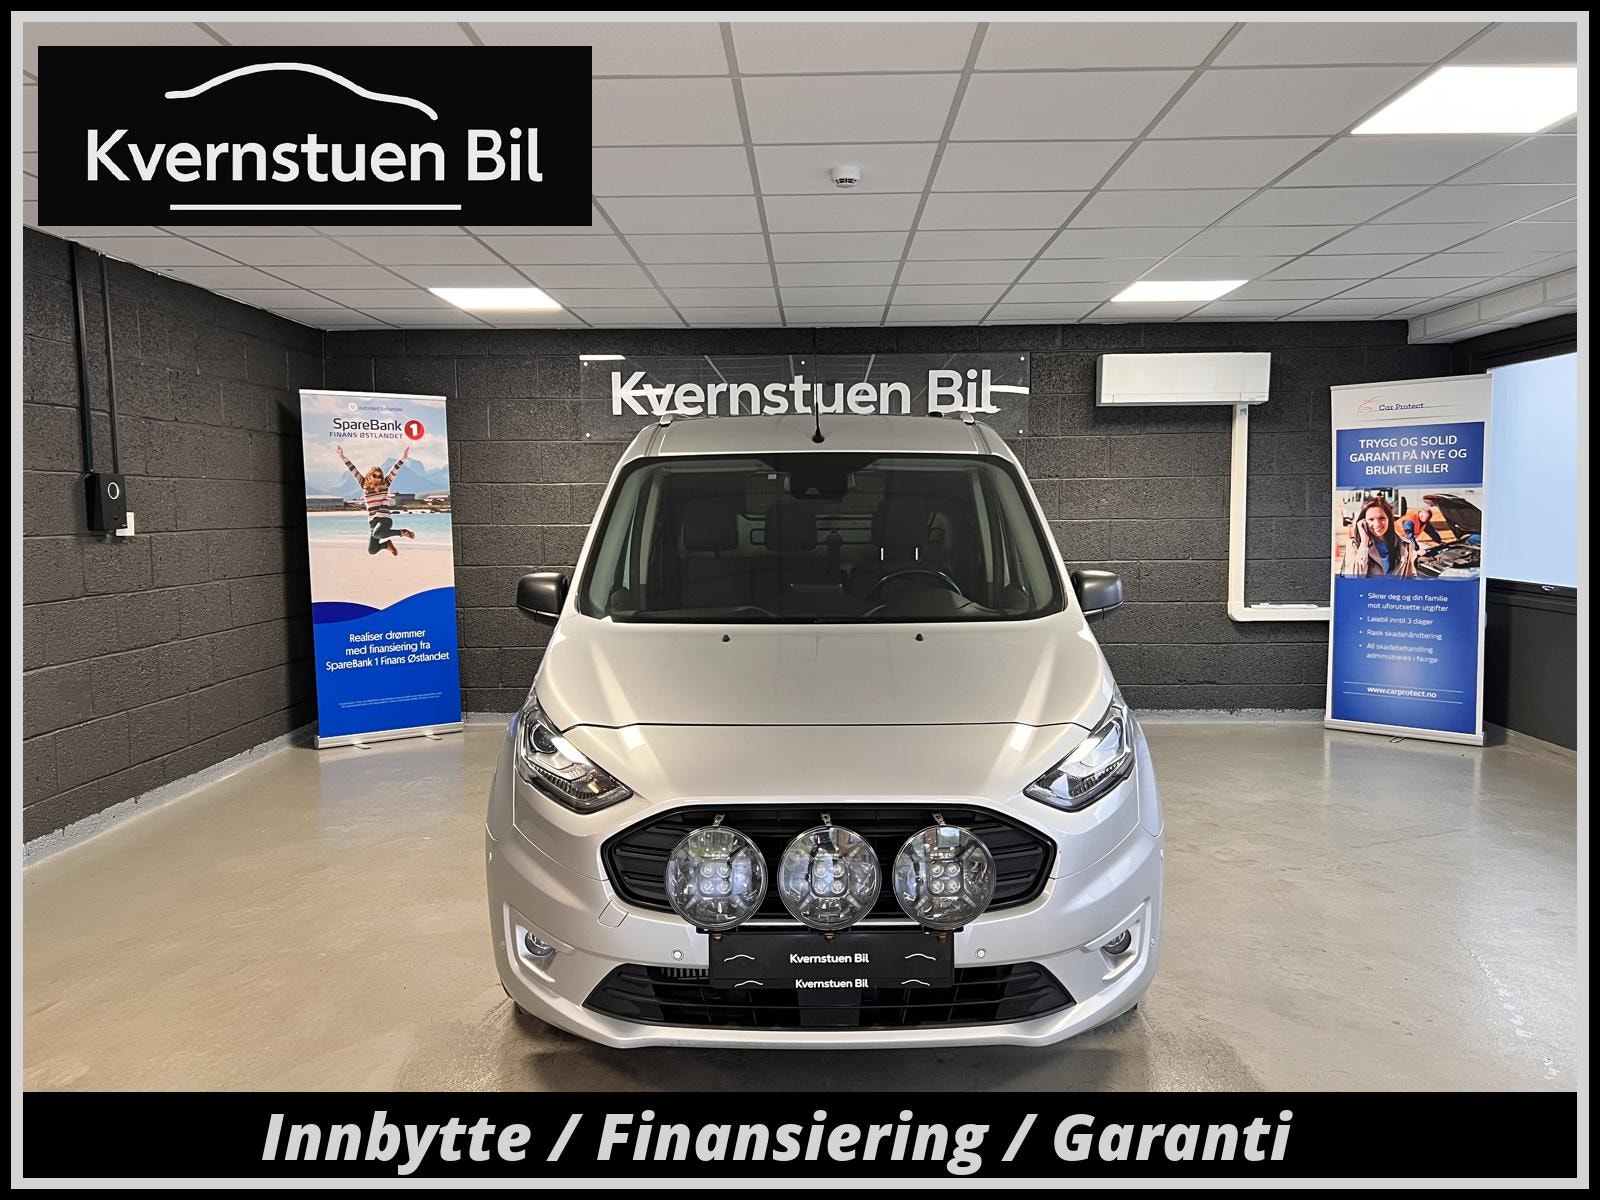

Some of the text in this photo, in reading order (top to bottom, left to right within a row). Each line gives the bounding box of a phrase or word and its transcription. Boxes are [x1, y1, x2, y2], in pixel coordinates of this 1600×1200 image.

[611, 369, 998, 416] Kvernstuen Bil
[1395, 402, 1424, 410] Protect
[333, 418, 418, 436] SpareBank 1
[1359, 435, 1457, 449] TRYGG OG SOLID
[1349, 449, 1467, 463] GARANTI PÅ NYE OG
[1366, 463, 1449, 475] BRUKTE BILER
[1387, 593, 1401, 601] deg
[1424, 594, 1448, 602] familie
[1382, 602, 1421, 611] uforutsette
[1421, 605, 1449, 613] utgifter
[1413, 618, 1434, 626] dager
[349, 630, 426, 643] Realiser drømmer
[345, 640, 431, 656] med finansiering fra
[326, 651, 450, 672] SpareBank 1 Finans Østlandet
[1416, 655, 1438, 664] Norge
[1367, 686, 1437, 699] www.carprotect.no
[789, 953, 870, 964] Kvernstuen Bil
[795, 978, 869, 988] Kvernstuen Bil
